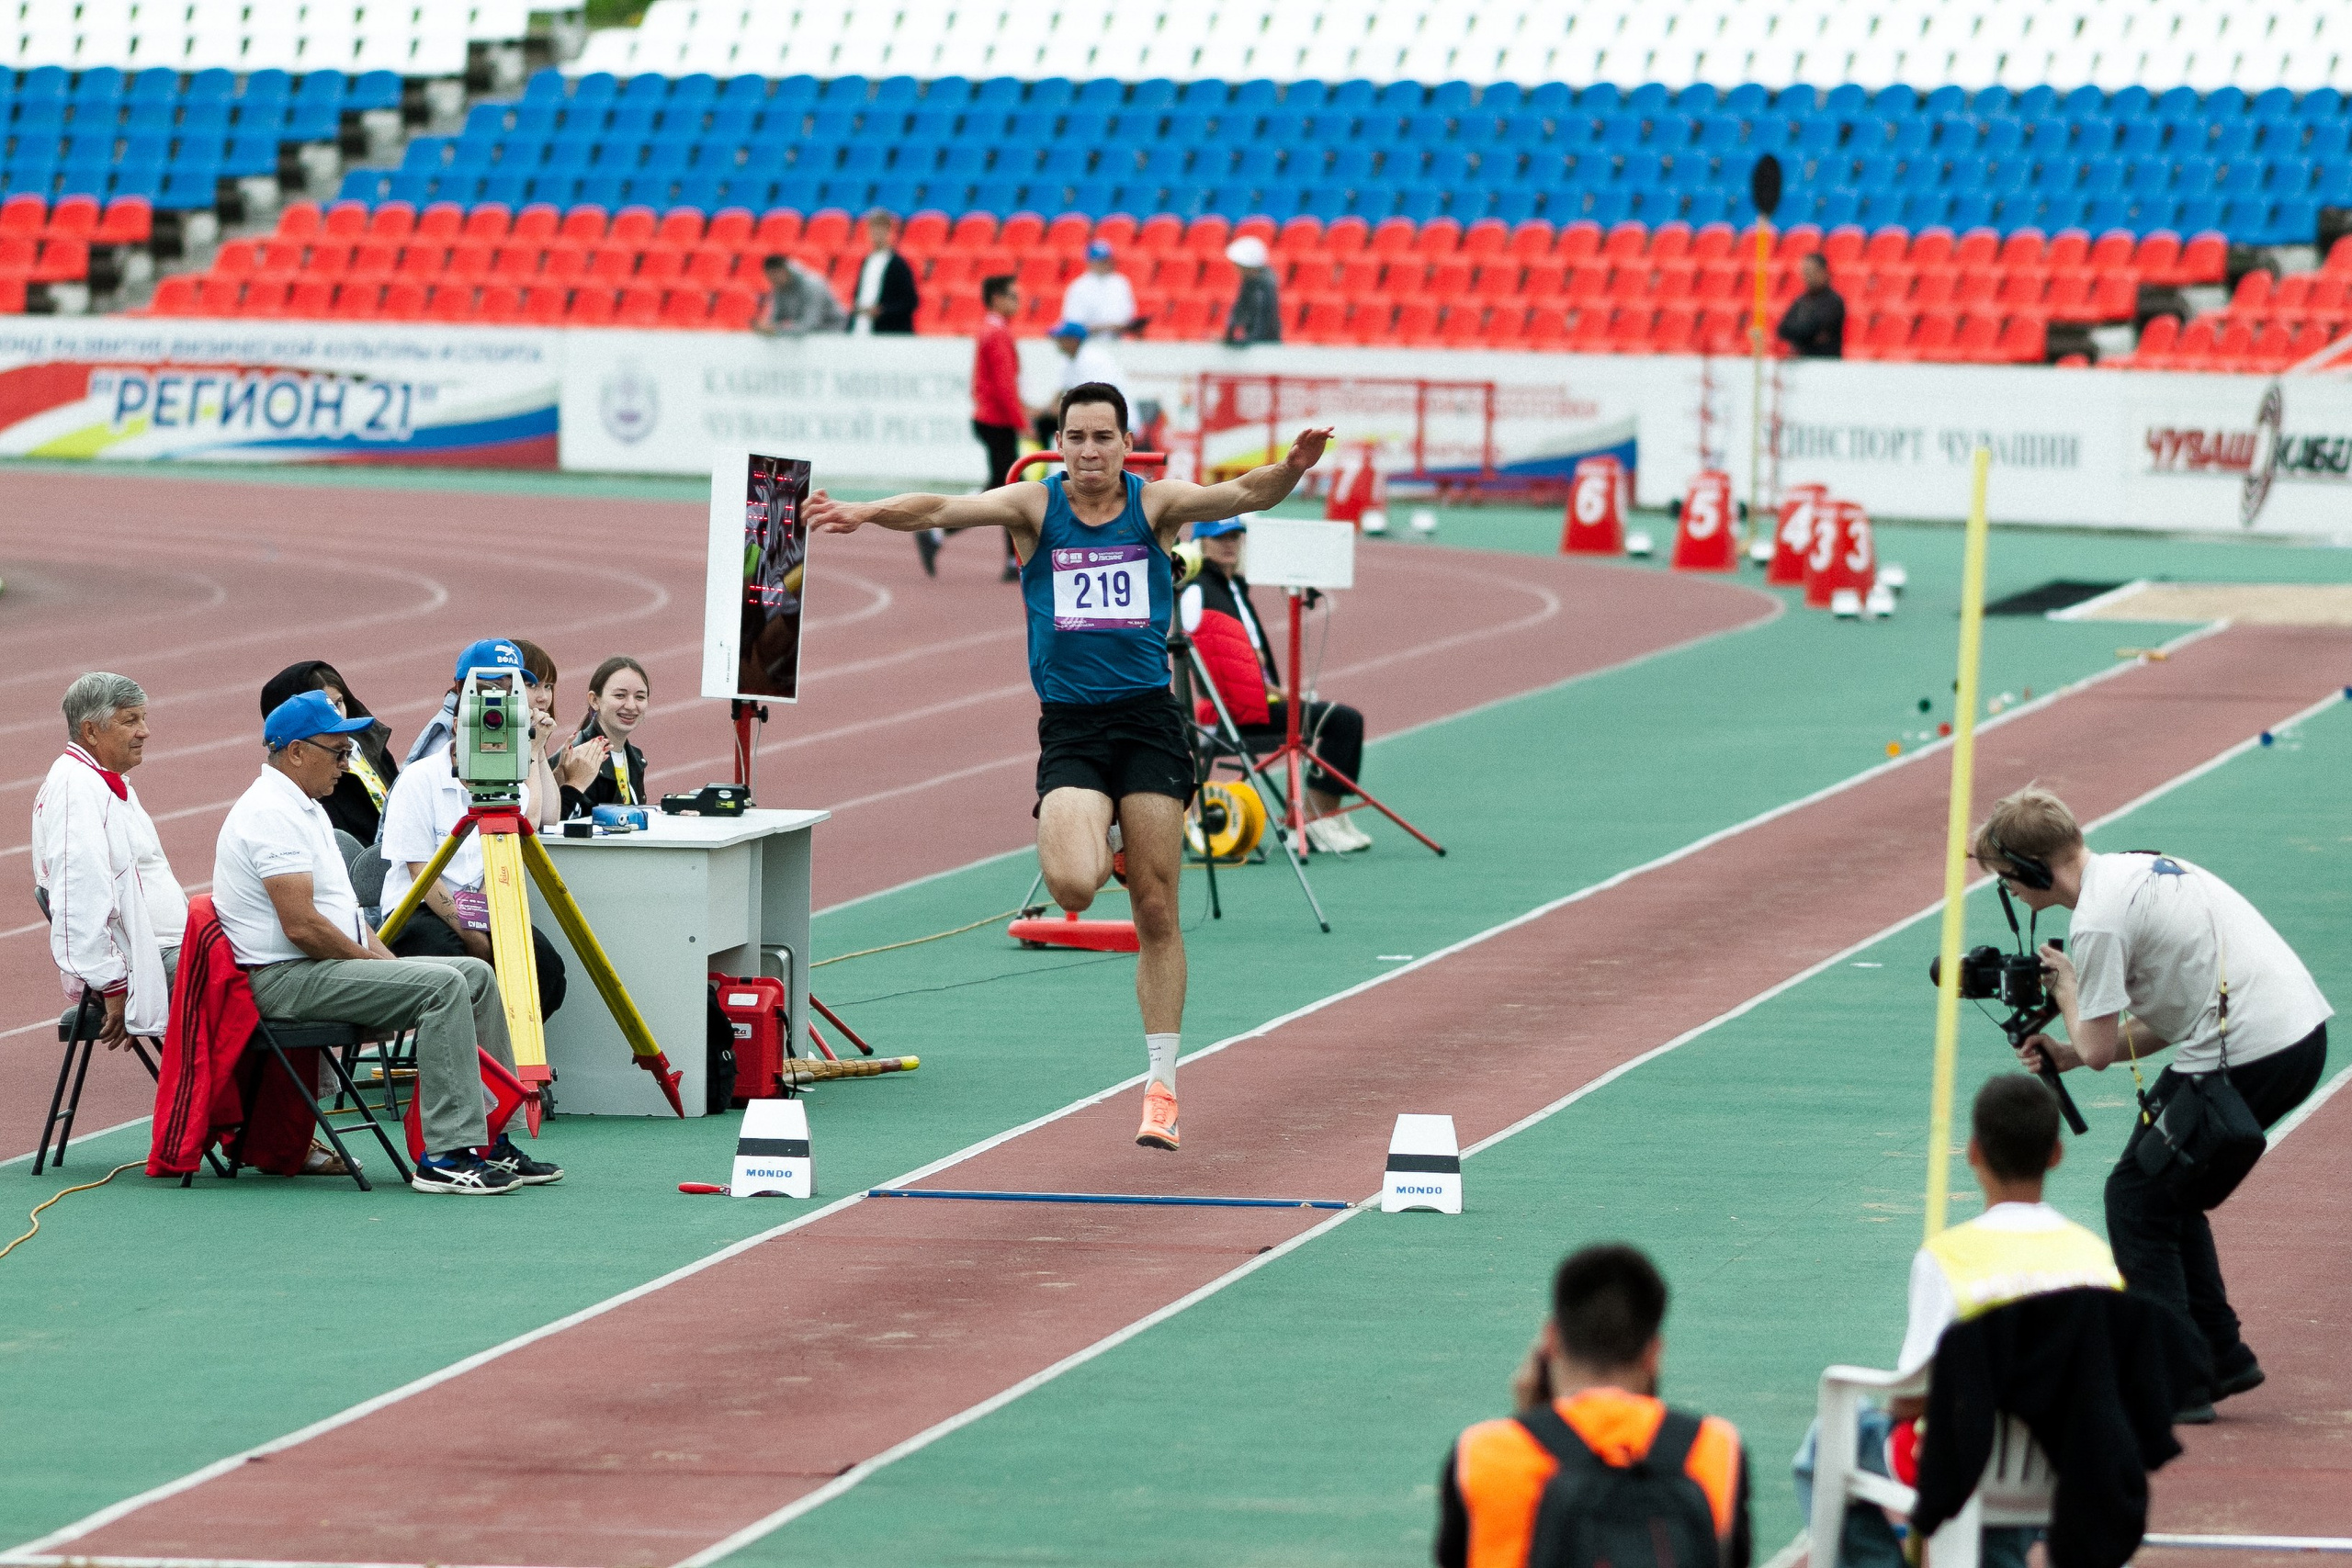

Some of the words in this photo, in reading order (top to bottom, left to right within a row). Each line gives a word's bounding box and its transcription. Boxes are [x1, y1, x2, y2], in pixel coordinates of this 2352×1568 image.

[1575, 477, 1606, 525] 6
[1686, 489, 1720, 539] 5
[1781, 501, 1813, 553] 4
[1808, 519, 1837, 571] 3
[1845, 519, 1871, 571] 3
[1074, 570, 1130, 608] 219
[496, 655, 519, 665] ВФЛА
[498, 865, 510, 887] Leica
[468, 920, 488, 930] СУДЬЯ
[746, 1168, 793, 1179] MONDO
[1396, 1186, 1442, 1195] MONDO
